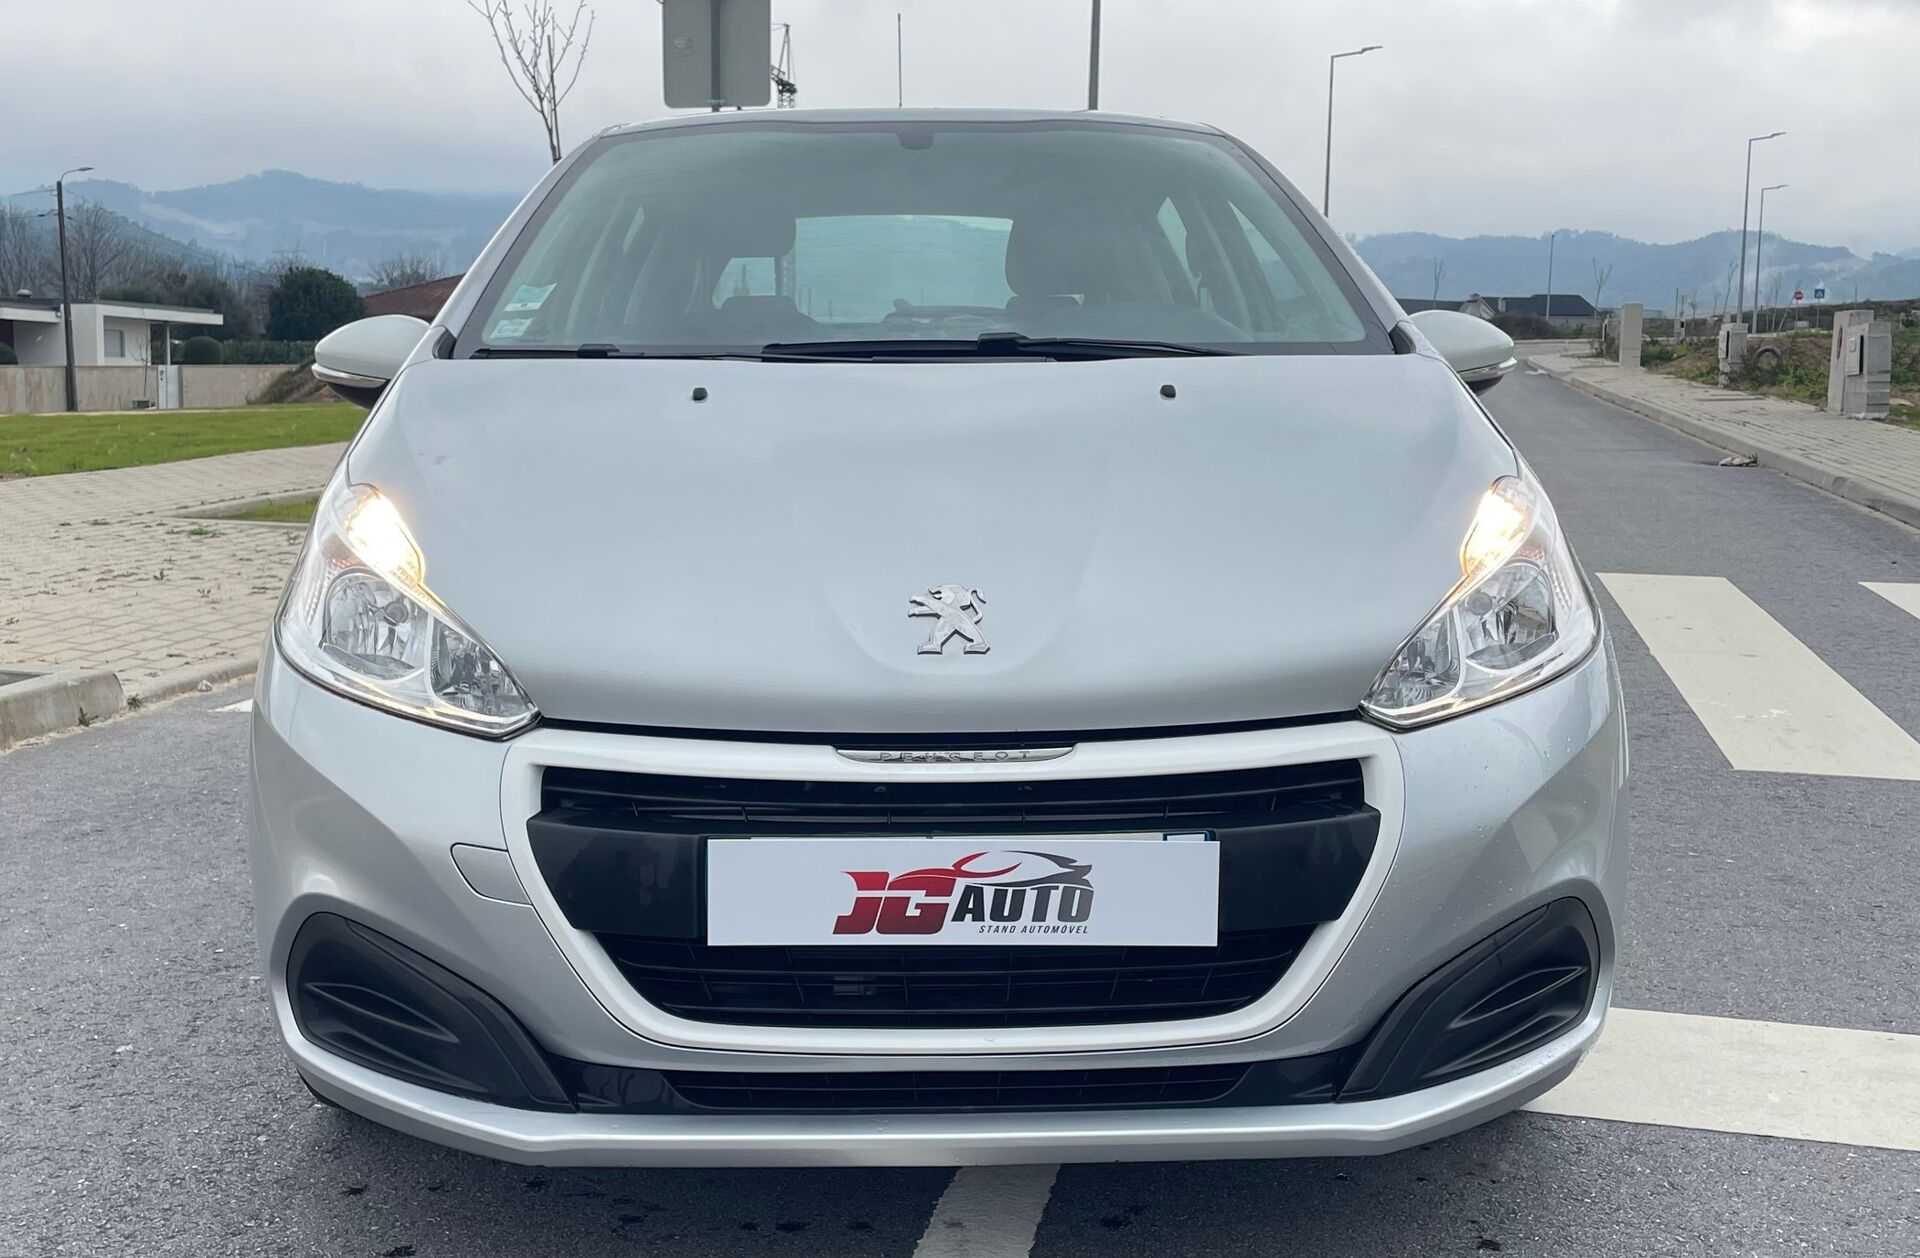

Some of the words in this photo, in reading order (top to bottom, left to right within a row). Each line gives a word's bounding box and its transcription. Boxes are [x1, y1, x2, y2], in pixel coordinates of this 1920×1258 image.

[879, 751, 1030, 763] PEUGEOT
[978, 924, 1016, 934] STAND
[1020, 923, 1088, 934] AUTOMÓVEL
